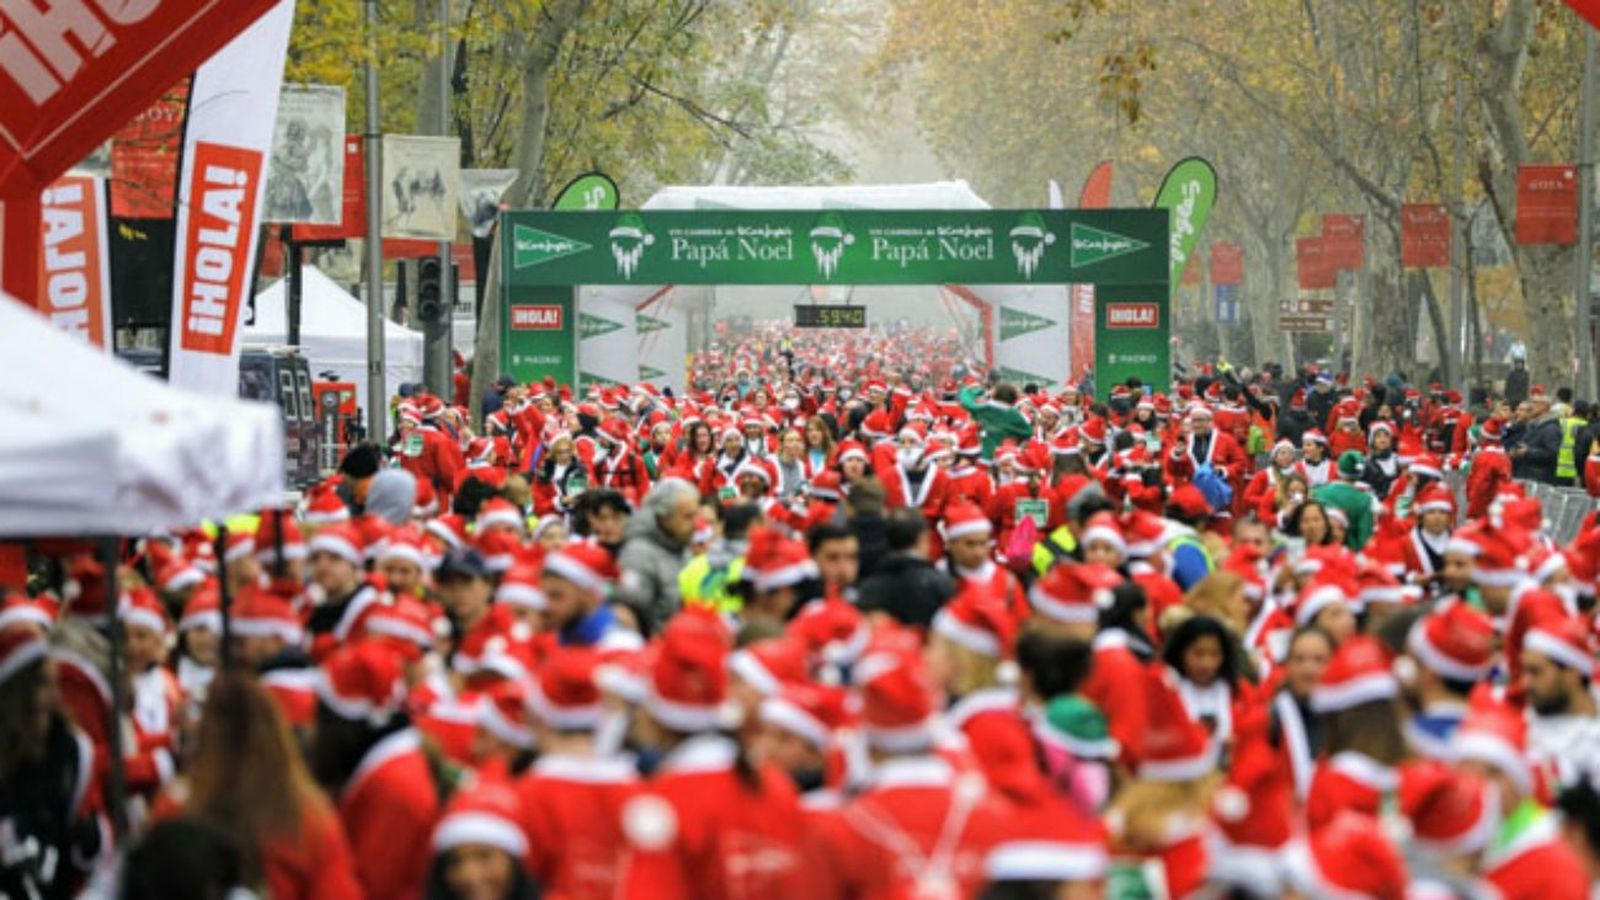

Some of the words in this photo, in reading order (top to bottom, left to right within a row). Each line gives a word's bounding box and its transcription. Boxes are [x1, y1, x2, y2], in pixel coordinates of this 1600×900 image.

[188, 164, 248, 336] ¡HOLA!
[670, 237, 730, 268] Papá
[737, 237, 793, 261] Noel
[871, 237, 930, 268] Papá
[938, 236, 994, 261] Noel
